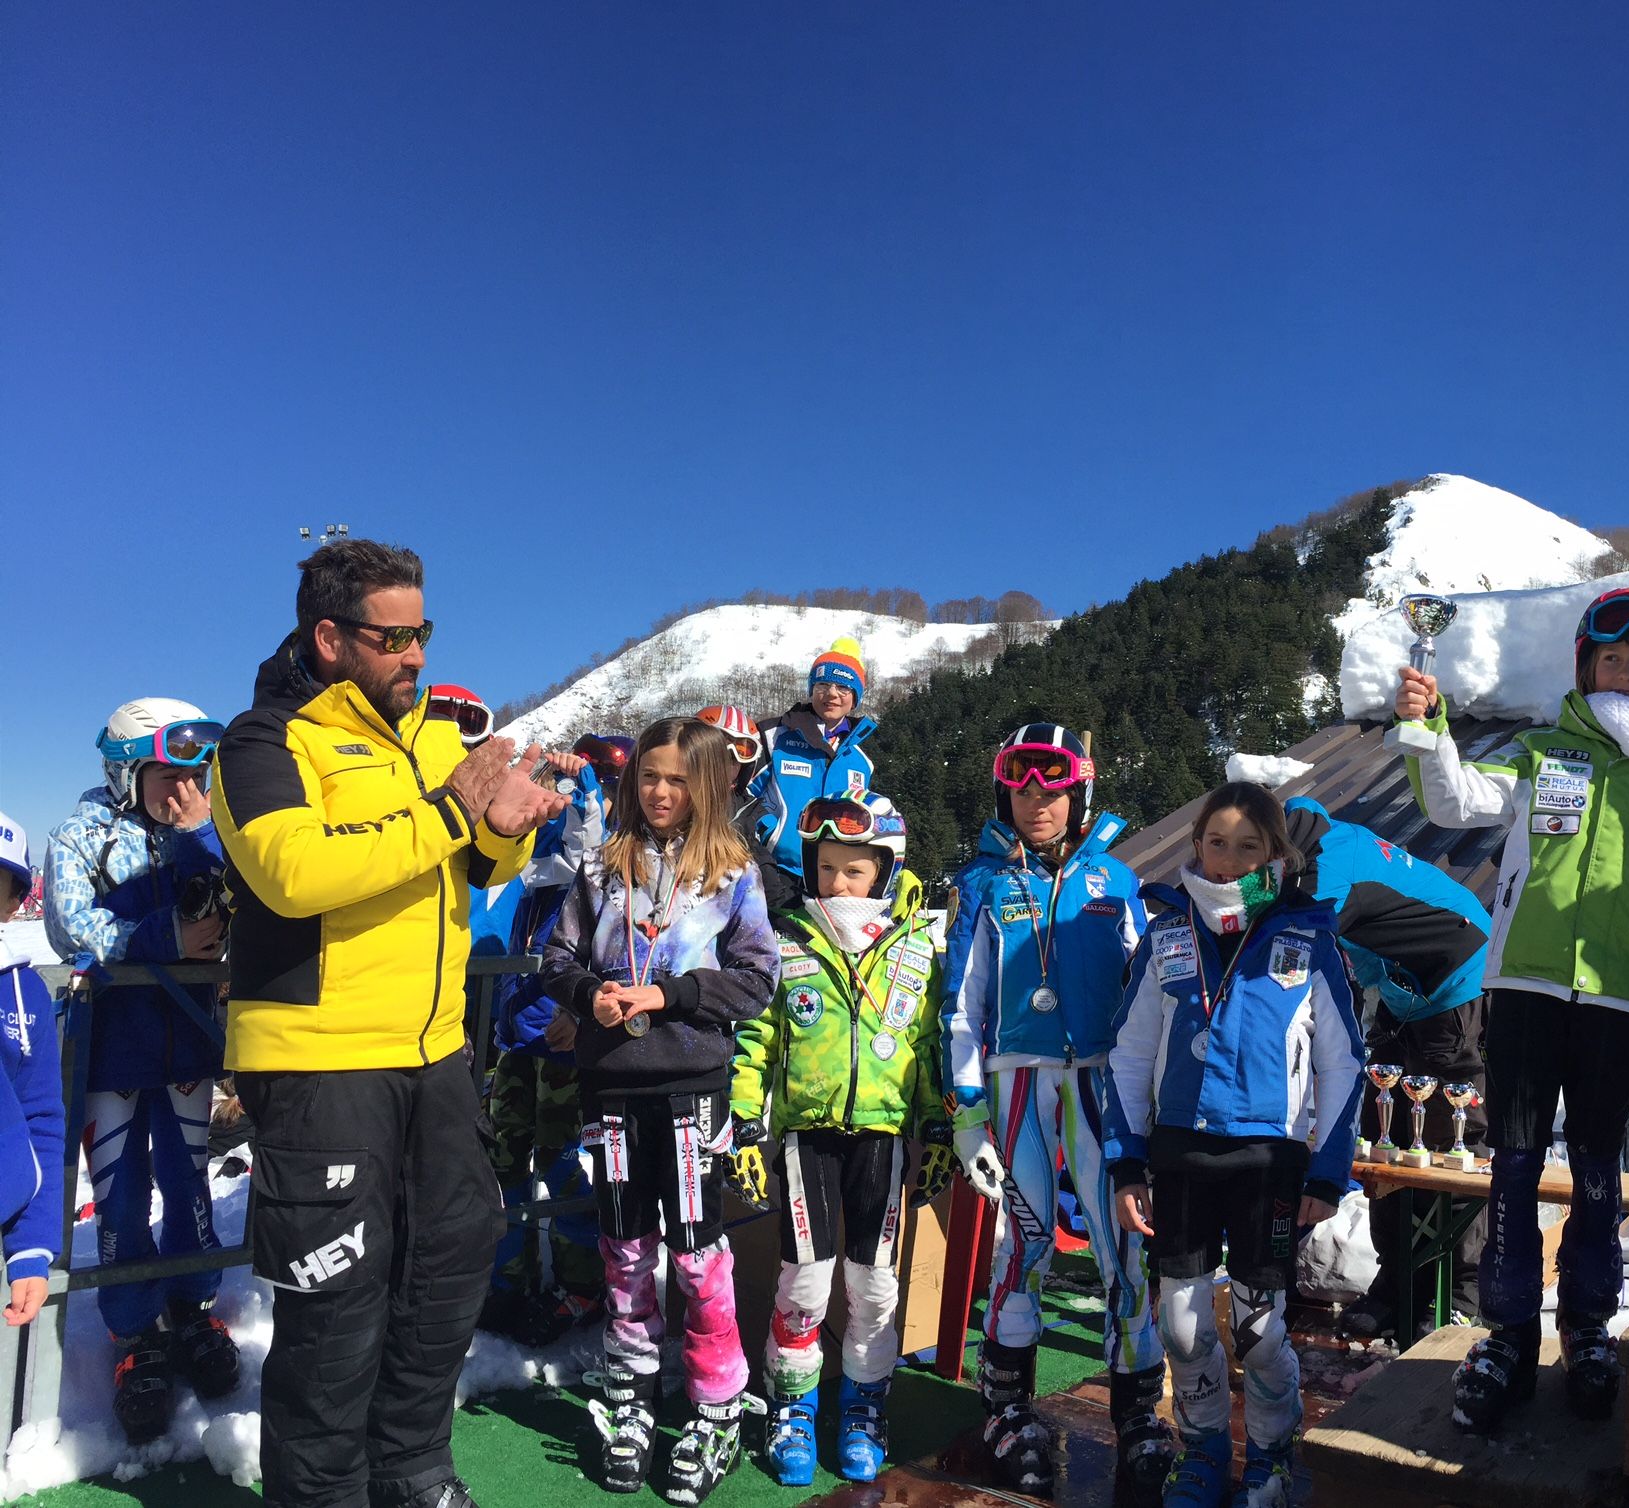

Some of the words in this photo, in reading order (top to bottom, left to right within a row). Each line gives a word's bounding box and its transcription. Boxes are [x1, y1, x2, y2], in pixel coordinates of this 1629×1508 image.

[1548, 749, 1574, 758] HEY
[1547, 763, 1588, 773] FENDT
[1552, 777, 1585, 787] REALE
[1538, 793, 1572, 804] biAuto
[1165, 929, 1192, 940] SECAP
[789, 963, 812, 973] CLOTY
[1272, 1198, 1291, 1258] HEY
[289, 1221, 365, 1289] HEY
